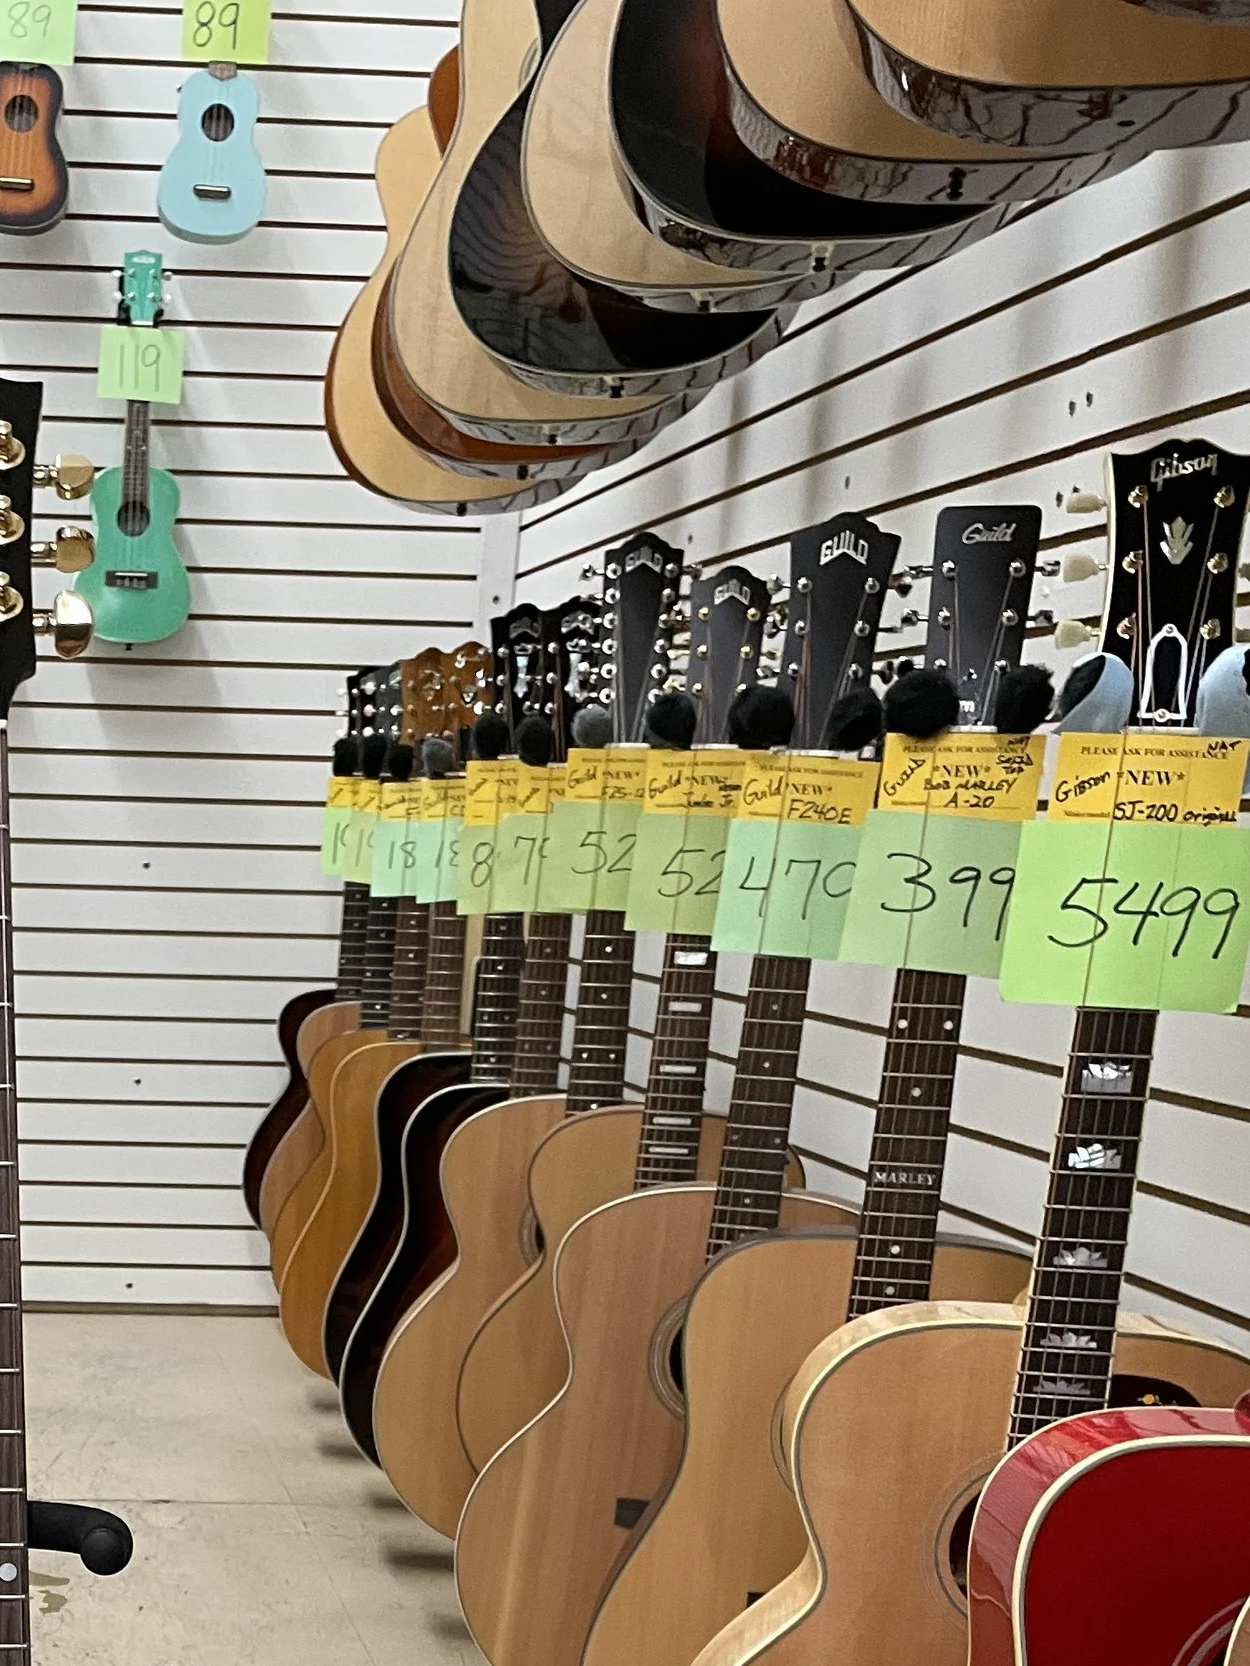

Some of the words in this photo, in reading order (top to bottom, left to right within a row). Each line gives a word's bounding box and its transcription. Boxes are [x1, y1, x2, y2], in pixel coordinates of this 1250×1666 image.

[8, 2, 51, 38] 89
[193, 1, 239, 49] 89
[119, 344, 160, 392] 119
[1150, 454, 1218, 492] Gibson
[819, 530, 869, 566] GUILD
[961, 522, 1016, 546] Guild
[1080, 746, 1118, 755] PLEASE
[1122, 748, 1141, 756] ASK
[1144, 748, 1165, 757] FOR
[649, 770, 683, 800] Guild
[743, 776, 784, 806] Guild
[1055, 771, 1110, 802] Gibson
[1124, 769, 1172, 786] NEW
[787, 799, 853, 825] F240E
[943, 791, 995, 808] A-20
[1113, 800, 1178, 822] SJ-200
[355, 828, 375, 868] 1
[571, 831, 637, 874] 52
[657, 848, 728, 898] 52
[880, 852, 1017, 942] 399
[1047, 876, 1241, 960] 5499
[873, 1171, 937, 1186] MARLEY
